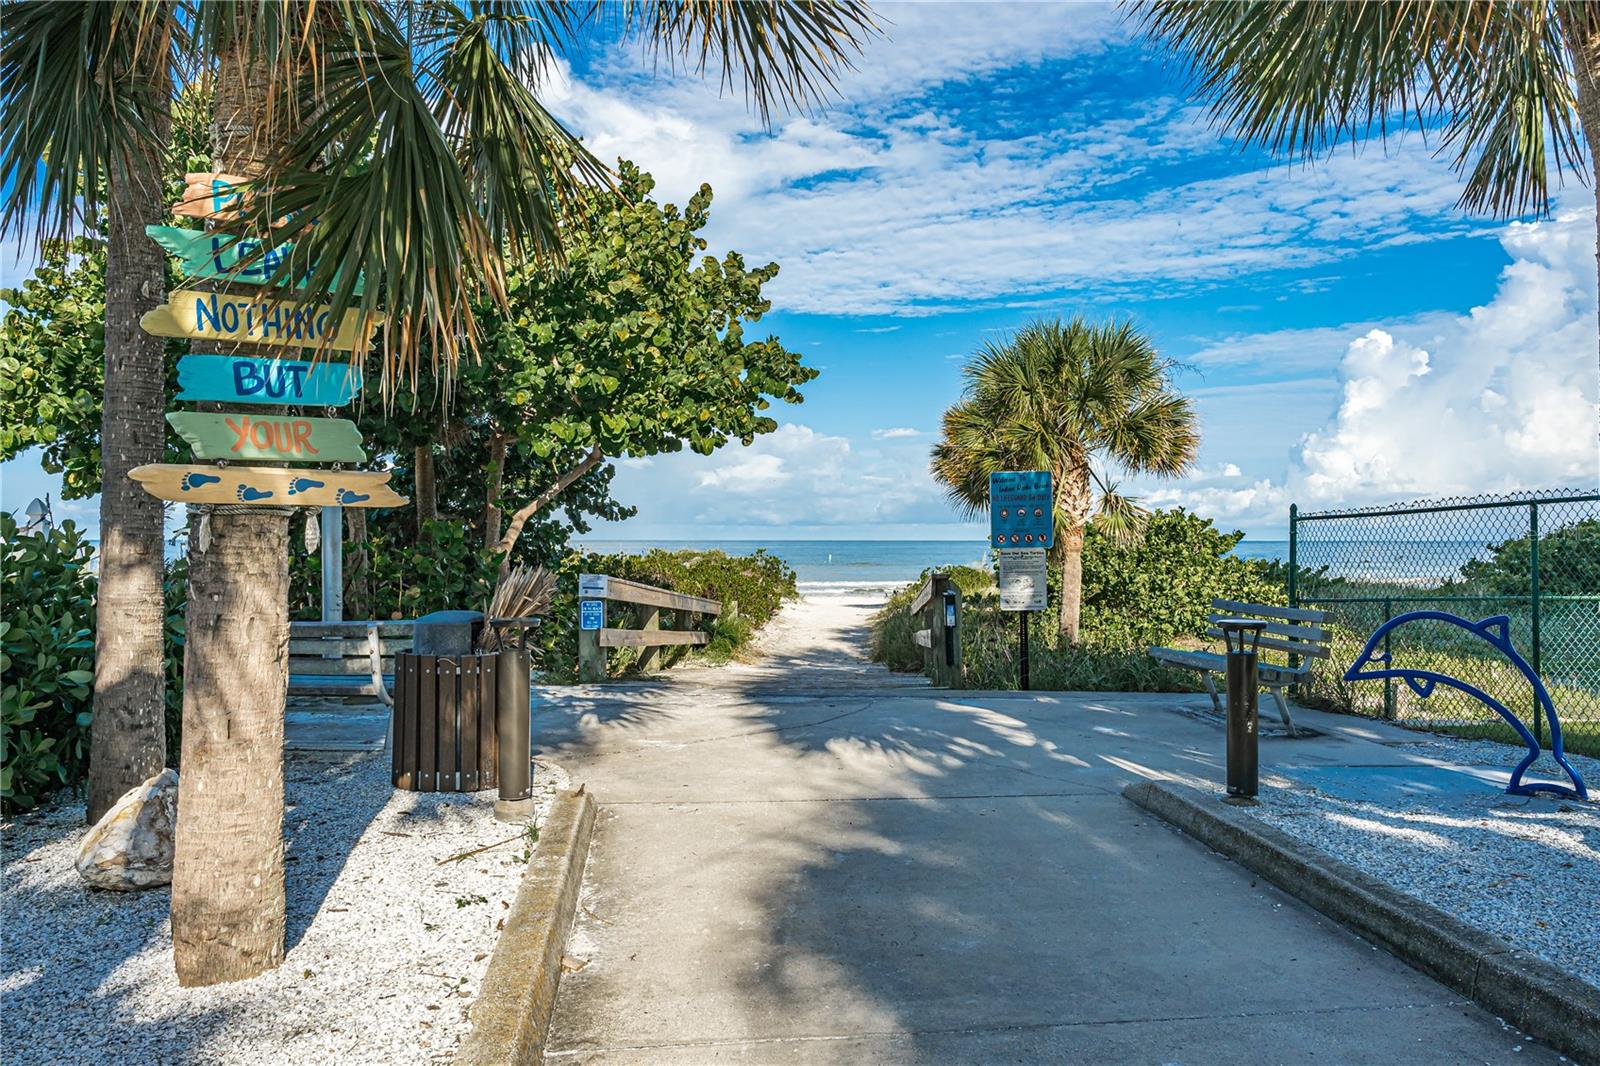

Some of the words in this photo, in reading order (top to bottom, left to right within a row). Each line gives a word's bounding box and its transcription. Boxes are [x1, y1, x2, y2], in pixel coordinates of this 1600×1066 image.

[211, 238, 320, 282] LEA
[196, 295, 338, 340] NOTHING
[232, 360, 308, 398] BUT
[225, 416, 318, 454] YOUR
